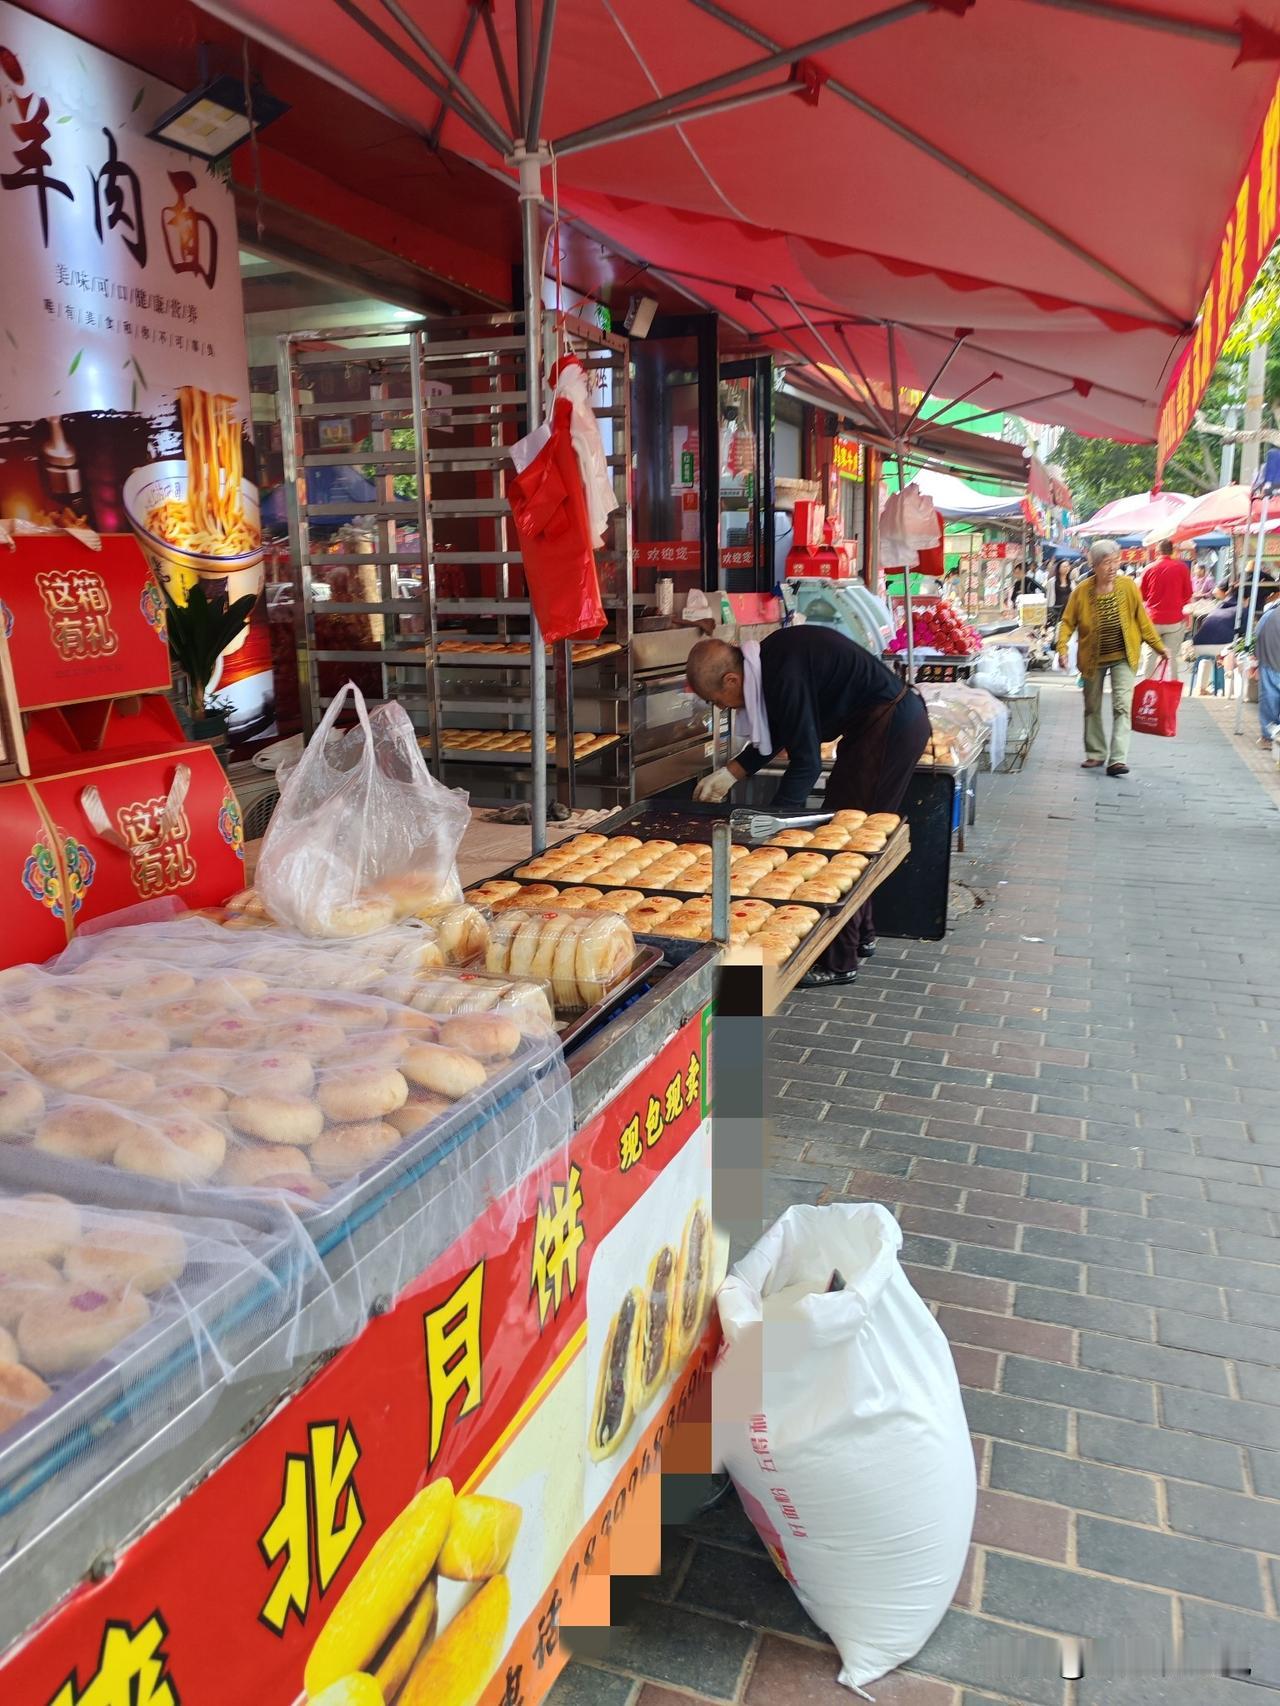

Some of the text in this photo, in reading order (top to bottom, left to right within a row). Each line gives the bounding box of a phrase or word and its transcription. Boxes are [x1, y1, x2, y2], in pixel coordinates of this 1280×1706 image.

[42, 577, 107, 613] 这箱
[55, 614, 114, 653] 有礼
[135, 843, 193, 891] 有礼
[619, 1051, 701, 1173] 现包现卖
